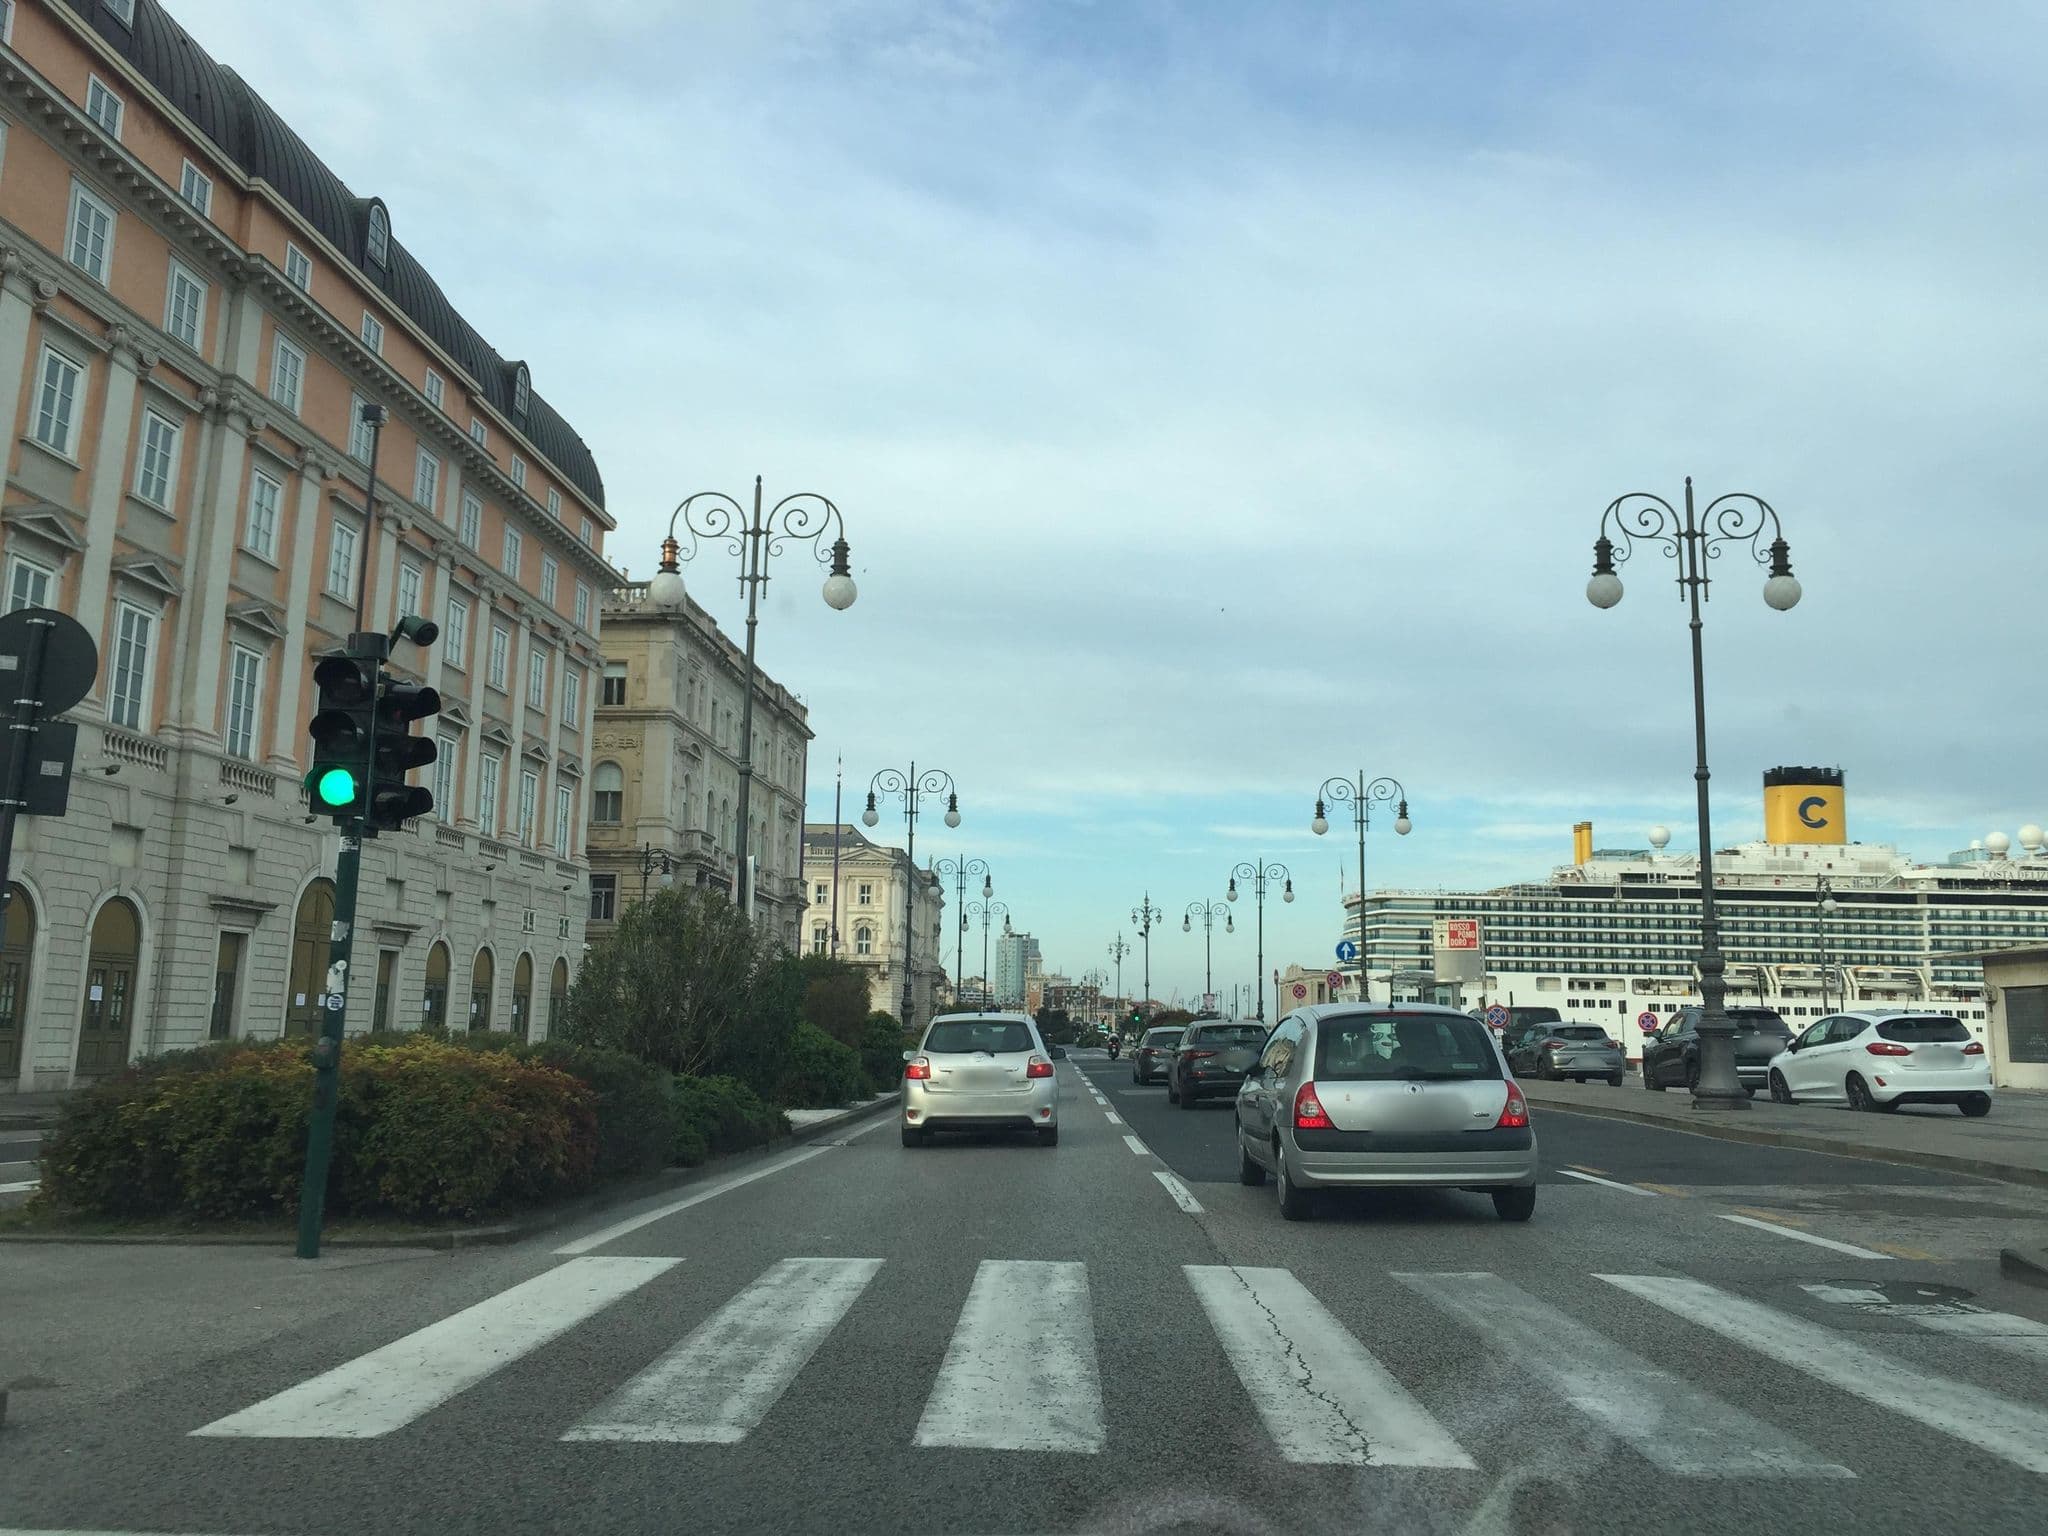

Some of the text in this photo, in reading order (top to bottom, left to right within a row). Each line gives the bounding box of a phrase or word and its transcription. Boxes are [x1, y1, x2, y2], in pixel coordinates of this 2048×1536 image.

[1798, 796, 1828, 828] C
[1982, 870, 2014, 879] COSTA
[1450, 922, 1470, 930] ROSSO
[1457, 930, 1475, 938] POMO
[1450, 938, 1467, 946] DORO
